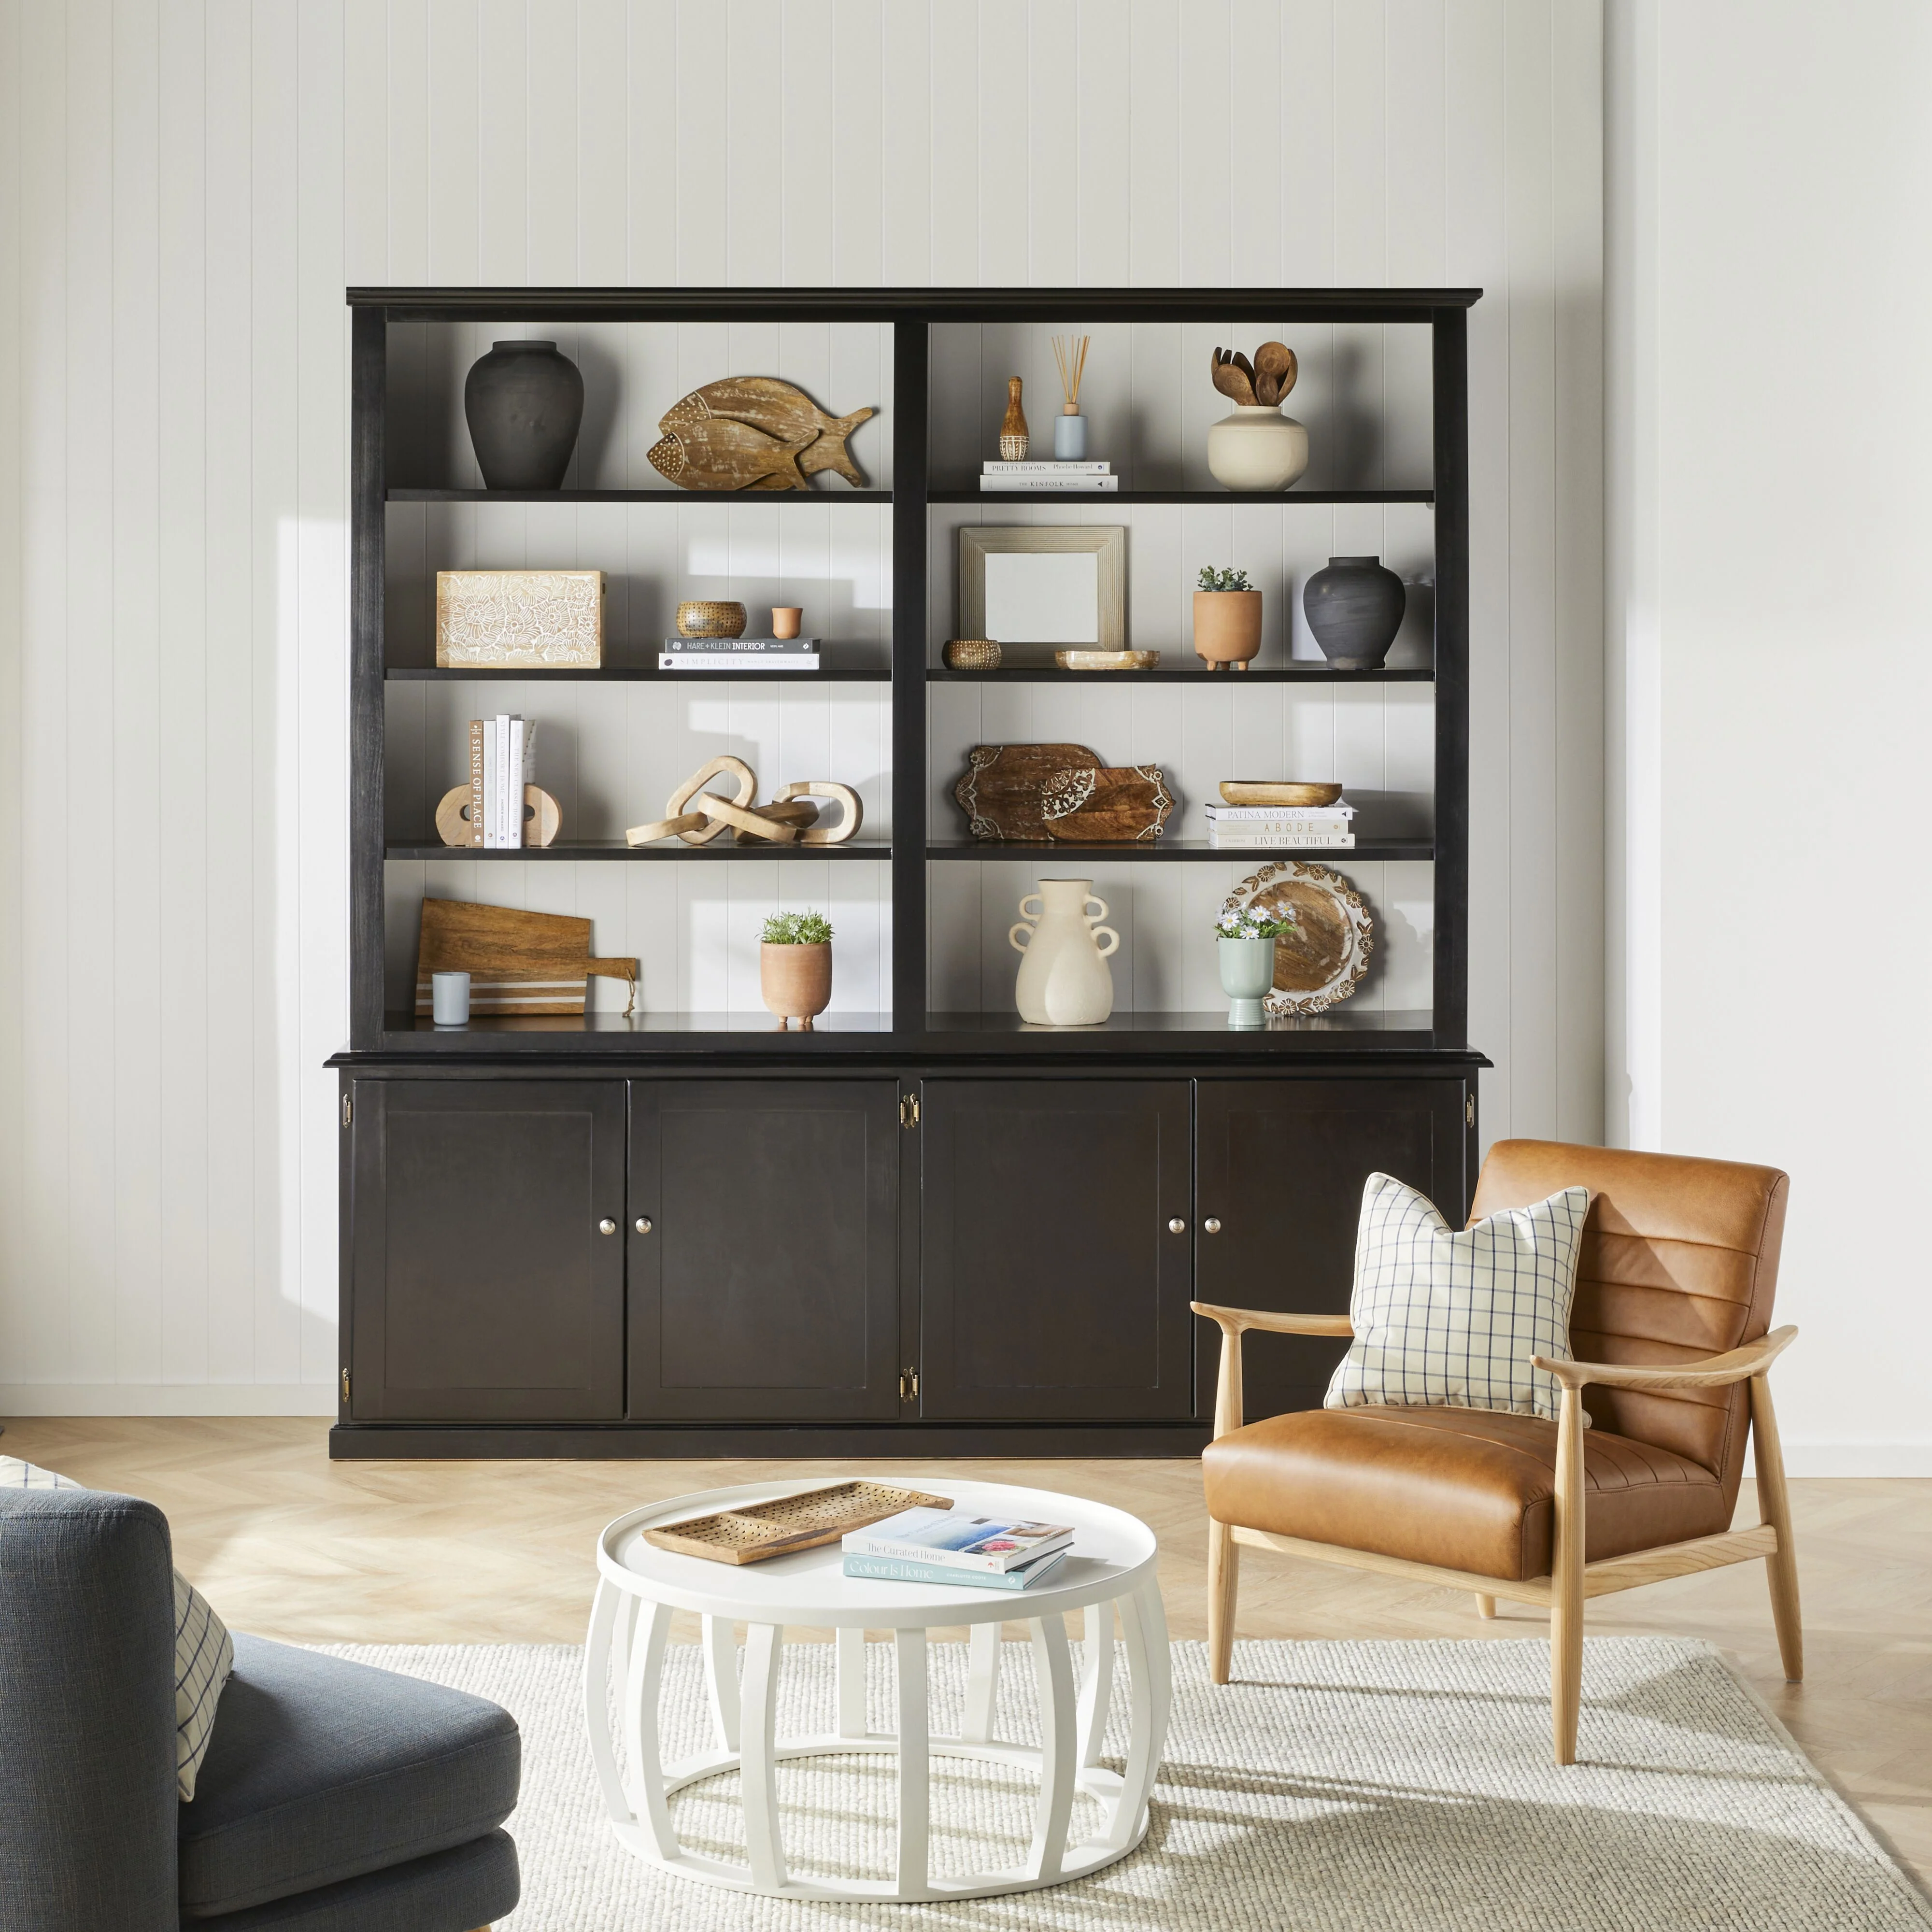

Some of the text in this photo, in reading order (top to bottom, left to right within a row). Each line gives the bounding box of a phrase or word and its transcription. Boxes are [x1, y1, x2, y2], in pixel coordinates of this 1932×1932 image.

[472, 739, 481, 775] SENSE
[473, 778, 481, 791] OF
[473, 794, 482, 828] PLACE
[1264, 823, 1314, 832] ABODE
[1254, 837, 1333, 845] LIVE BEAUTIFUL
[867, 1542, 882, 1553] The
[883, 1544, 919, 1558] Curated
[920, 1549, 946, 1562] Home
[850, 1561, 934, 1579] Colour Is Home
